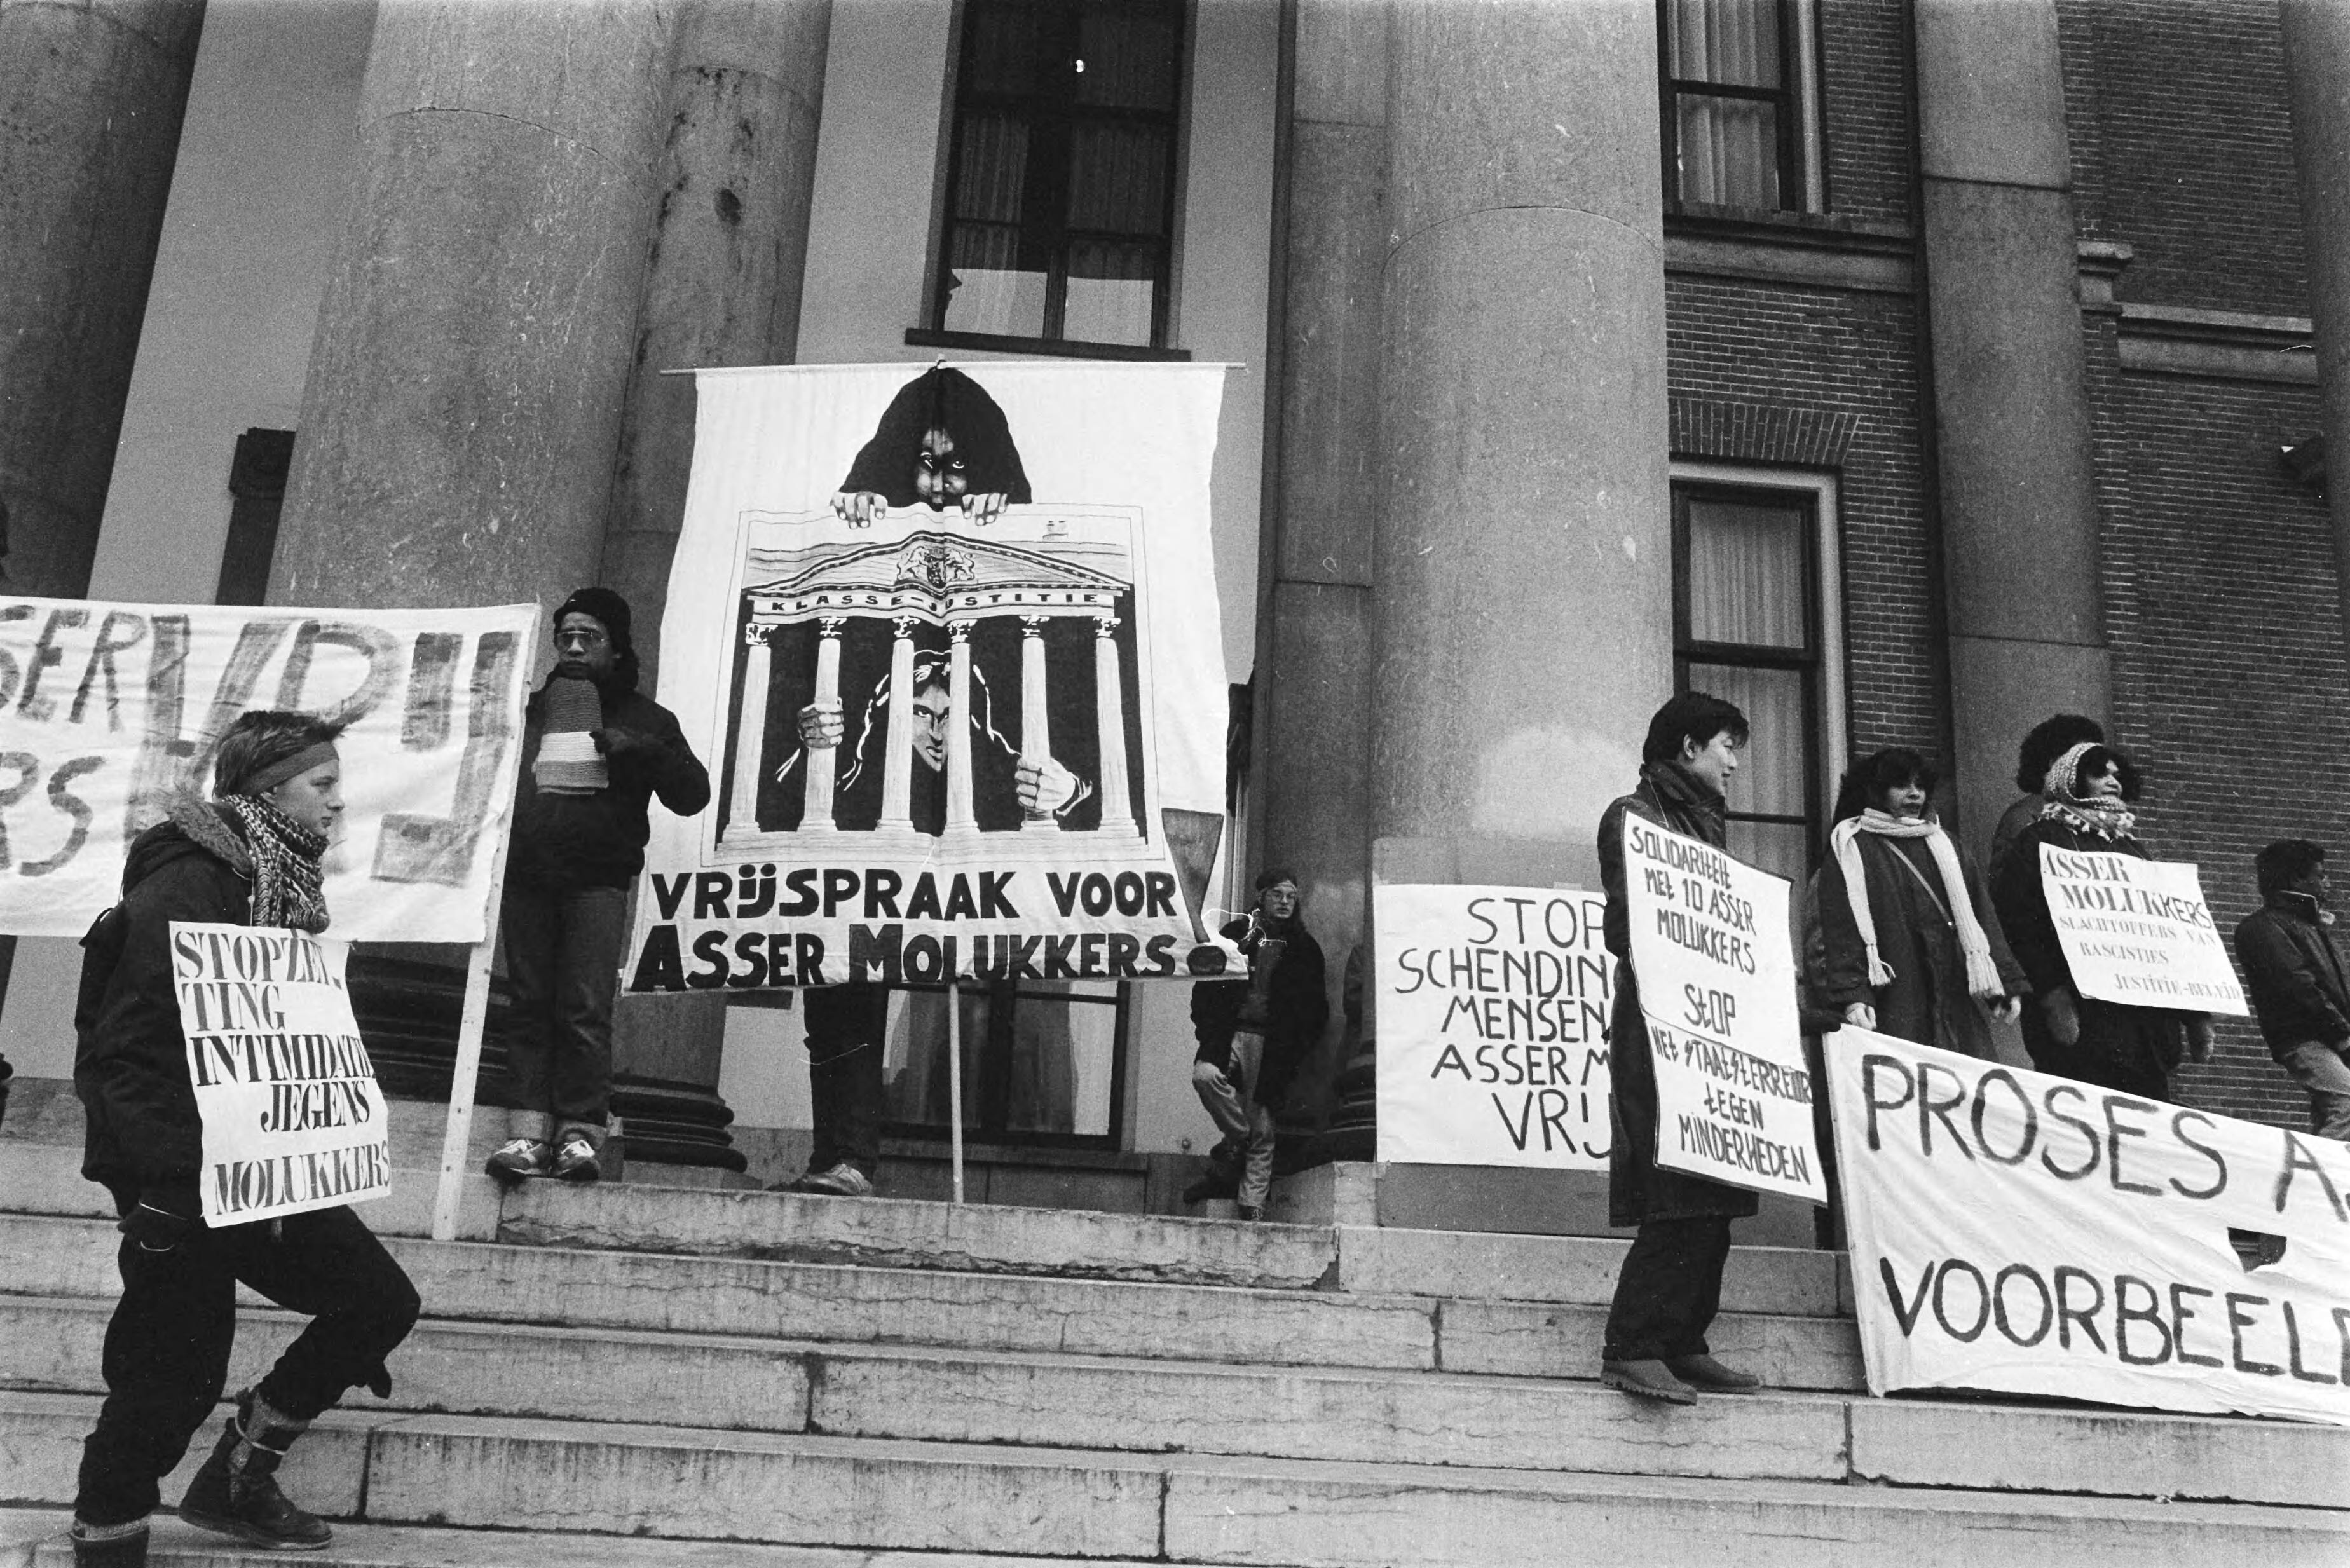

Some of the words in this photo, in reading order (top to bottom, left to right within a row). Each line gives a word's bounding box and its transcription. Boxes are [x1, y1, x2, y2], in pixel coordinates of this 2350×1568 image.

[772, 594, 1097, 611] KLASSE-JUSTITIE
[2044, 850, 2131, 882] ASSER
[1046, 871, 1177, 917] VOOR
[1682, 878, 1703, 912] 10
[1709, 889, 1757, 936] ASSER
[2060, 884, 2211, 929] MOLUKKERS
[1468, 898, 1604, 949] STOP
[1657, 908, 1755, 975] MOLUKKERS
[2060, 917, 2176, 939] SLACHTOFFERS
[631, 924, 827, 992] ASSER
[182, 983, 285, 1032] TING
[1441, 995, 1609, 1044] MENSEN
[1431, 1044, 1571, 1086] ASSER
[261, 1080, 370, 1132] JEGENS
[1862, 1054, 2227, 1200] PROSES
[2274, 1128, 2350, 1222] A
[215, 1140, 390, 1215] MOLUKKERS
